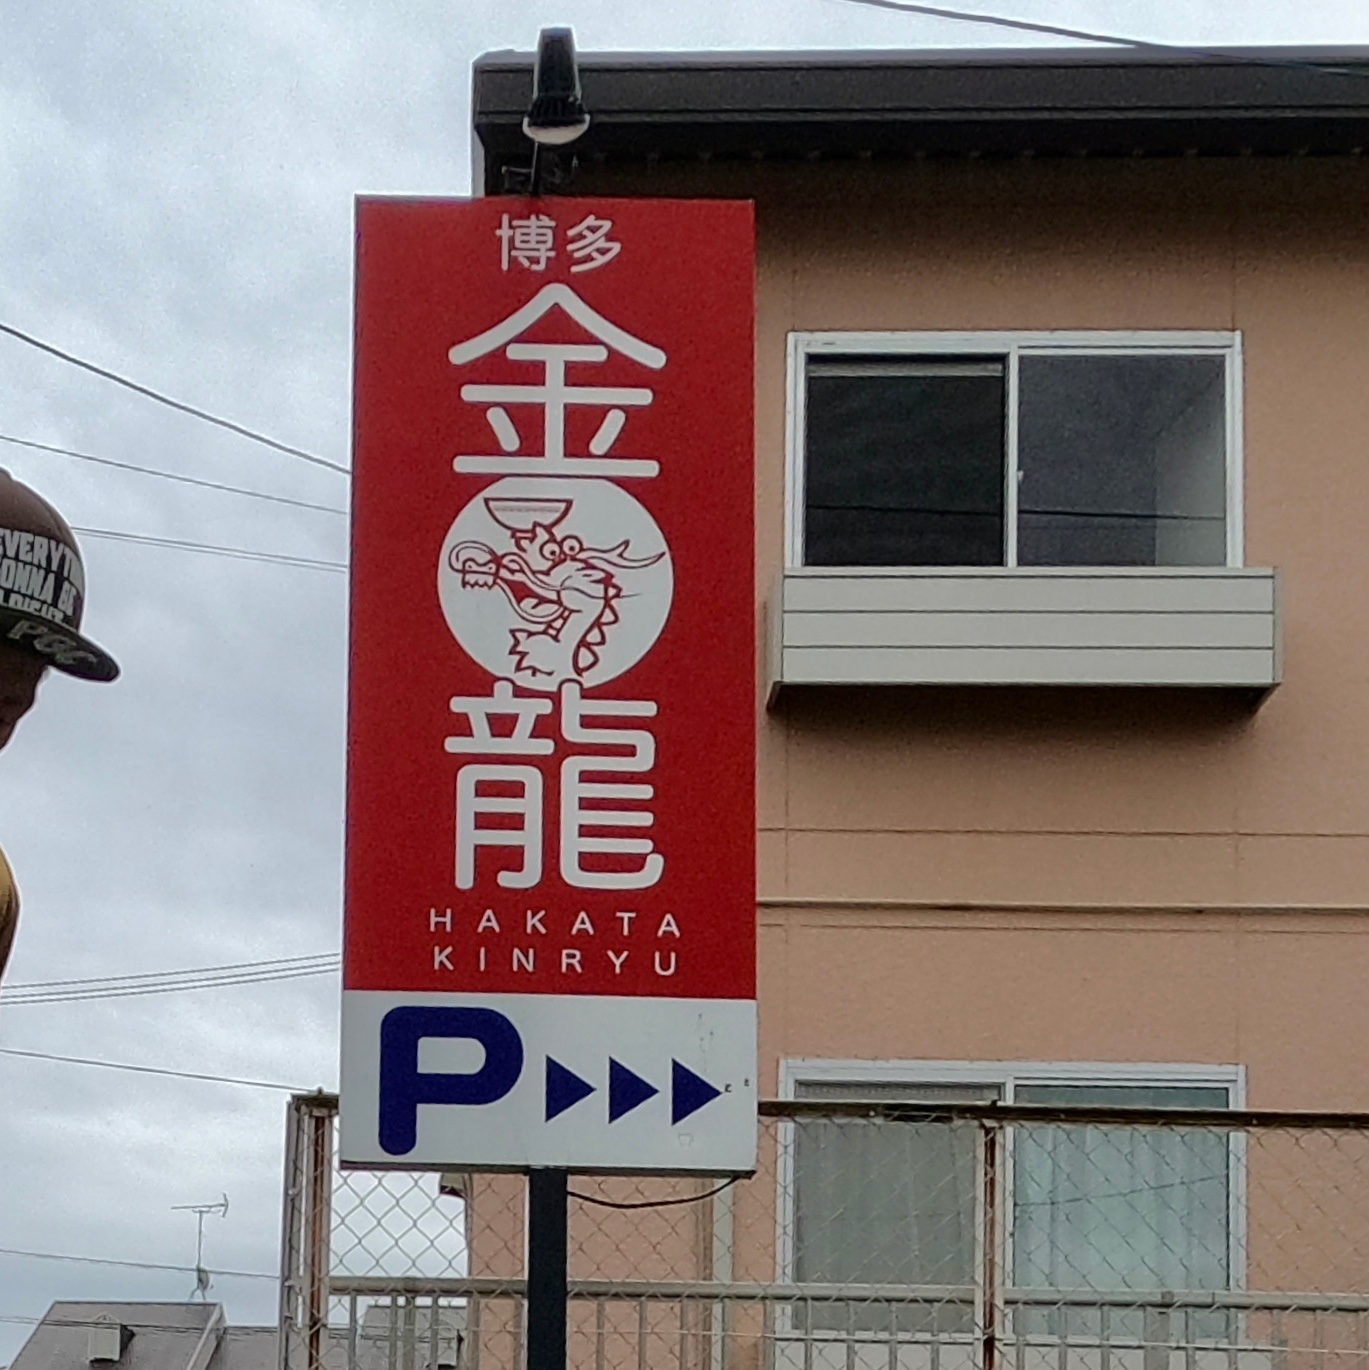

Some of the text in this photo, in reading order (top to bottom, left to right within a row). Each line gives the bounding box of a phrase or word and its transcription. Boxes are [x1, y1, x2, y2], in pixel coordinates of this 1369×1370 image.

[495, 213, 622, 273] 博多
[429, 907, 681, 939] HAKATA
[433, 946, 677, 977] KINRYU
[378, 1005, 524, 1156] P
